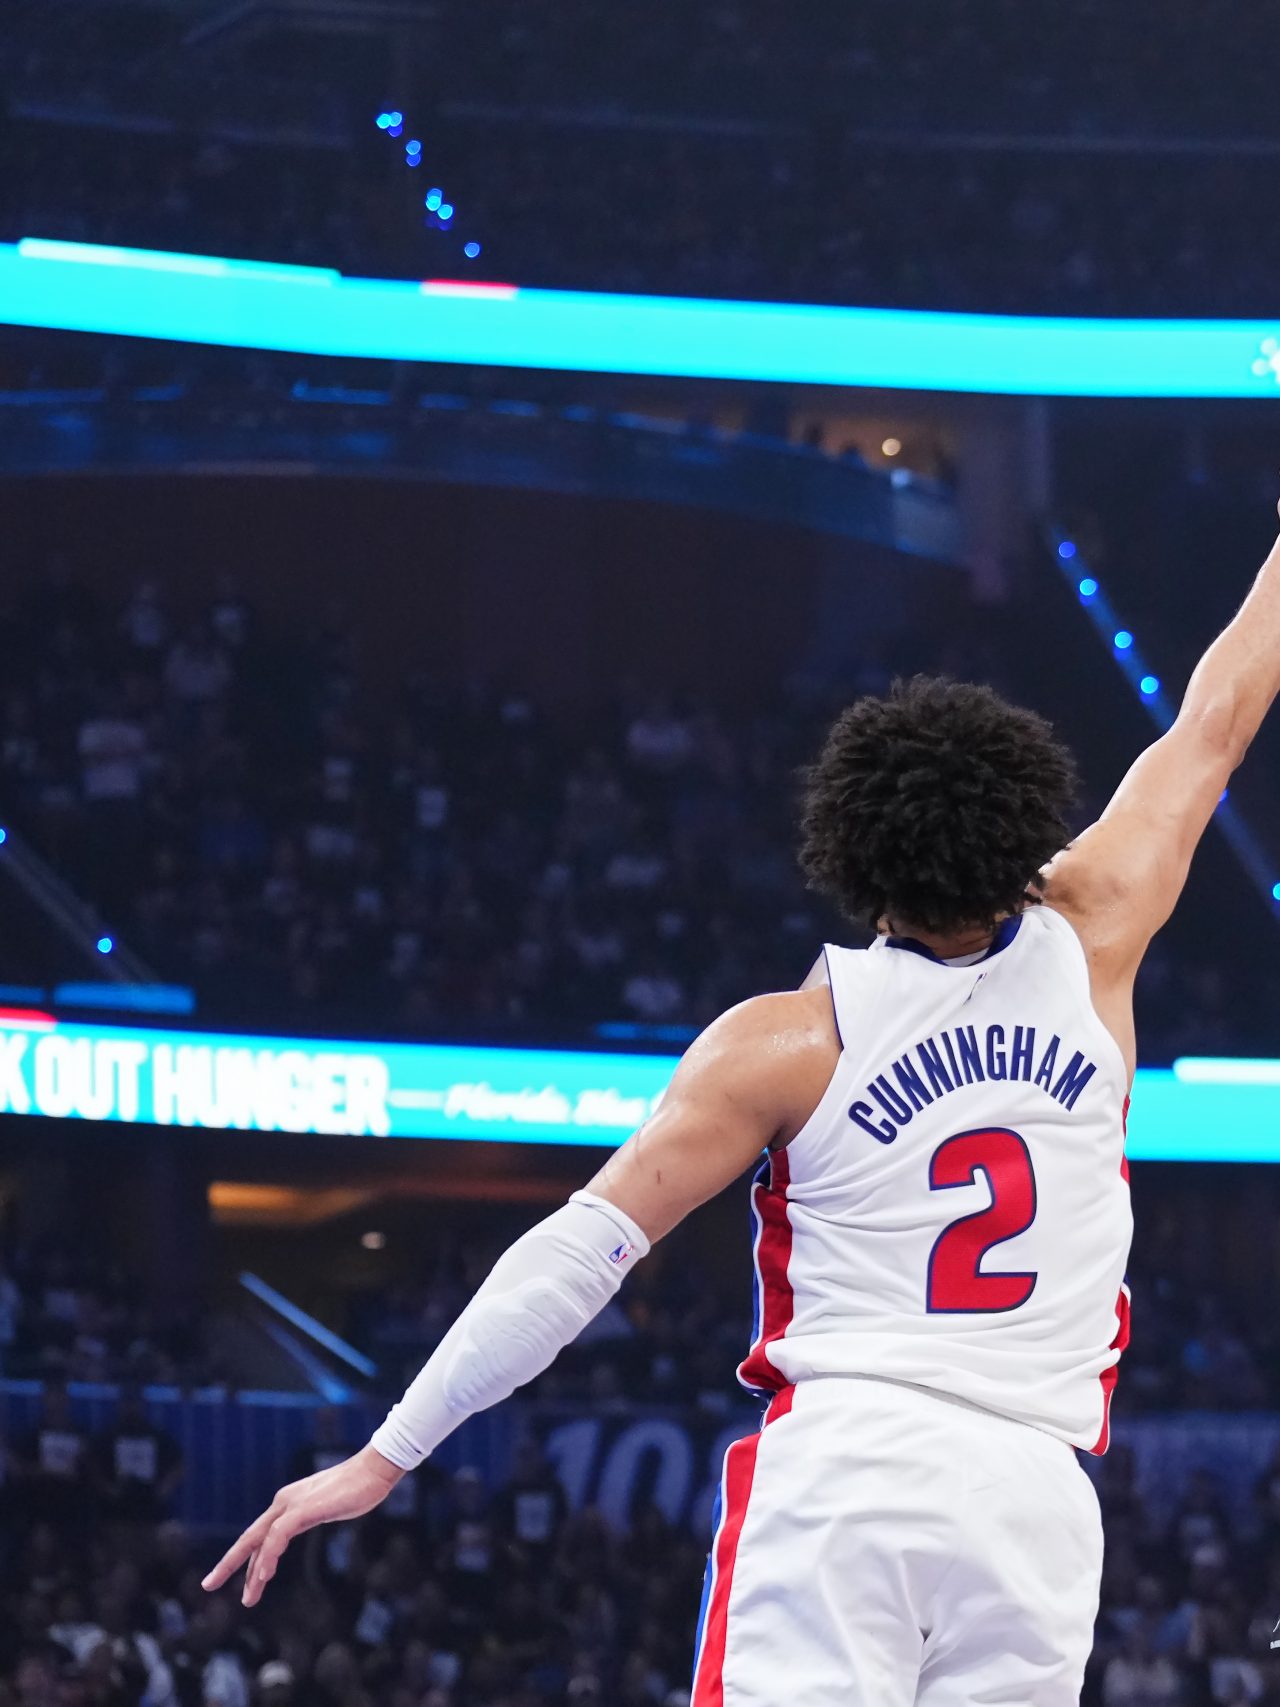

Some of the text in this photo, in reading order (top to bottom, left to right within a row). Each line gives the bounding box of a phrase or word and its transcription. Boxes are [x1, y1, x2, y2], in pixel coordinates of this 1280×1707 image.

[34, 1034, 148, 1121] OUT
[152, 1043, 391, 1137] HUNGER
[848, 1024, 1097, 1145] CUNNINGHAM
[926, 1127, 1038, 1314] 2
